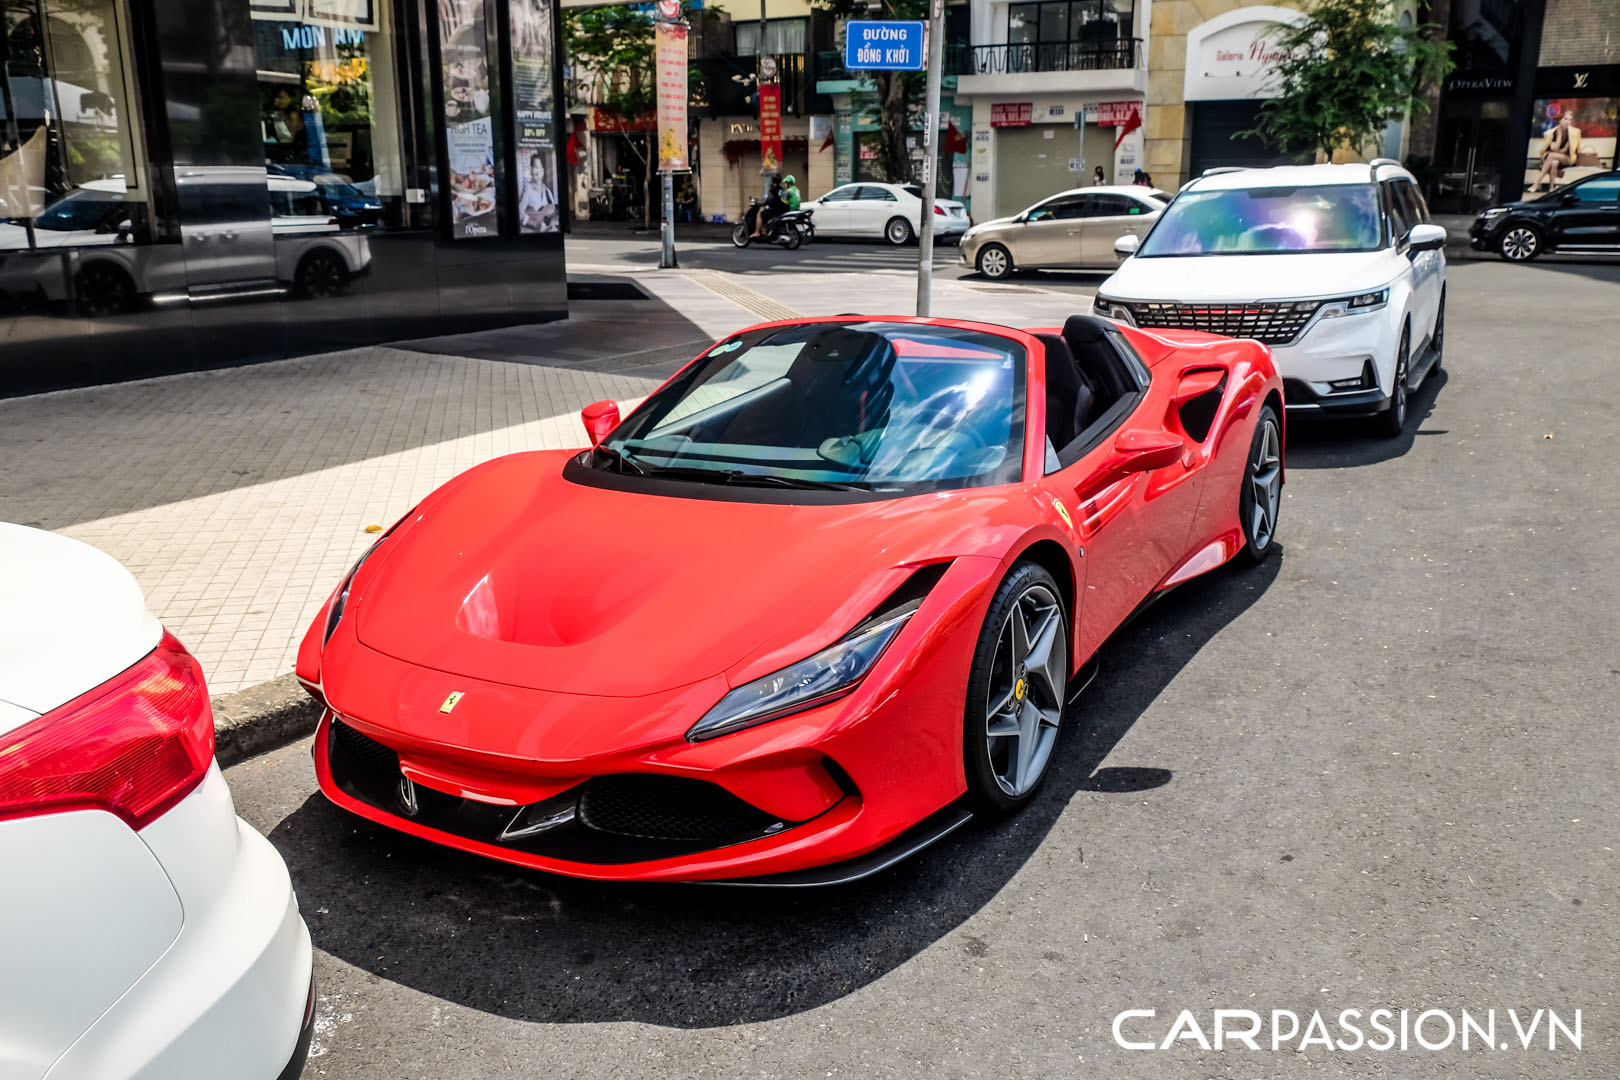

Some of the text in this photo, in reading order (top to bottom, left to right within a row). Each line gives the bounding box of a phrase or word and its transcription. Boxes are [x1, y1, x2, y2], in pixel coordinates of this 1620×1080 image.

[863, 26, 907, 40] ĐƯỜNG
[857, 42, 909, 63] ĐỒNG KHỞI
[1217, 49, 1243, 61] Galerie
[471, 122, 488, 135] TEA
